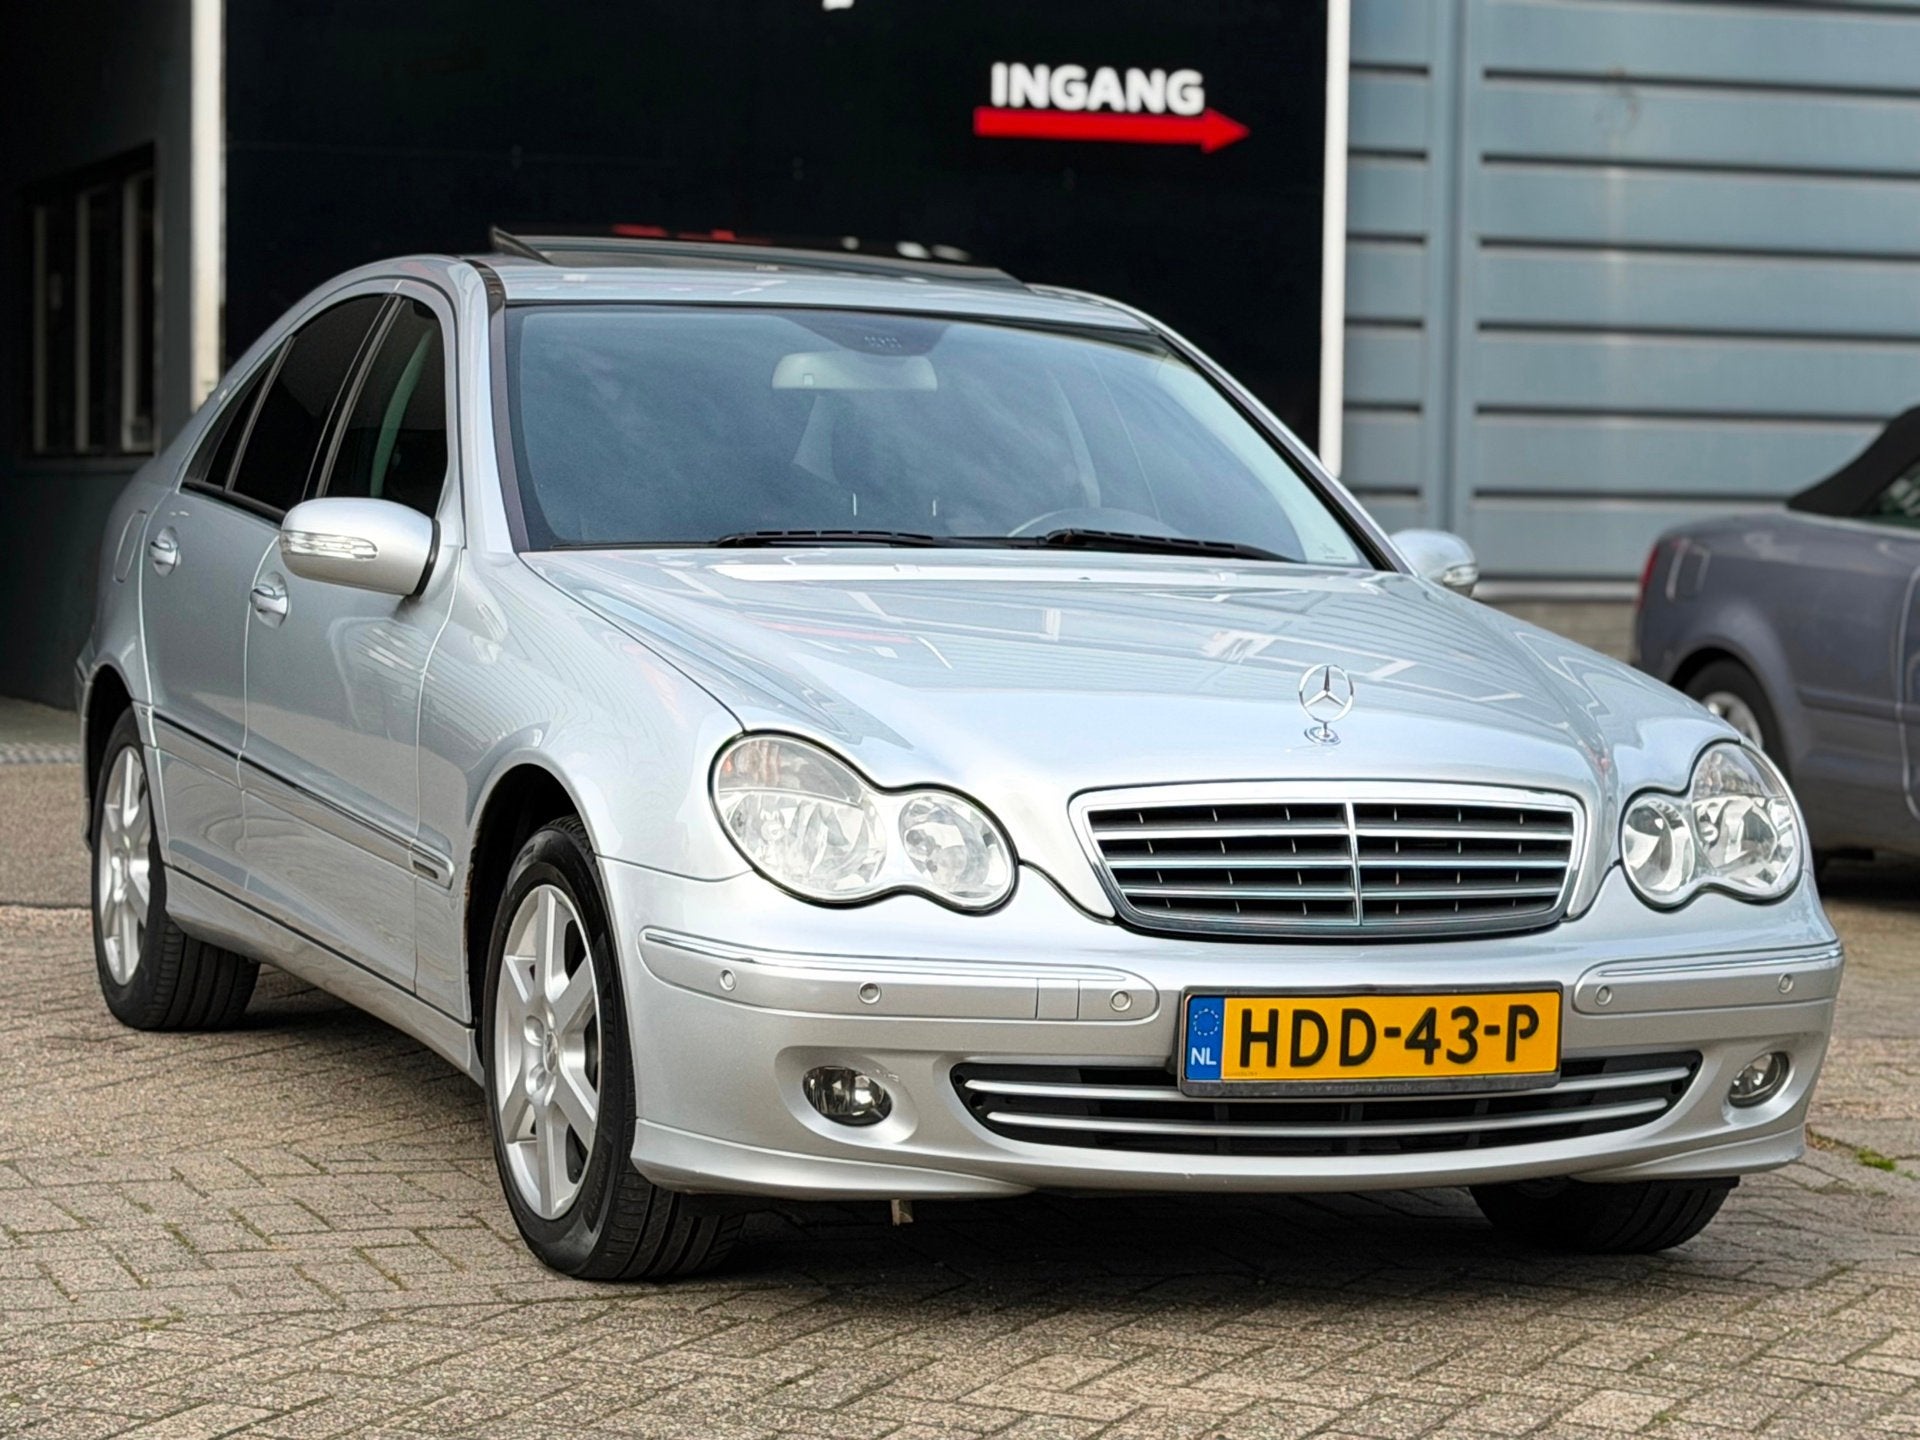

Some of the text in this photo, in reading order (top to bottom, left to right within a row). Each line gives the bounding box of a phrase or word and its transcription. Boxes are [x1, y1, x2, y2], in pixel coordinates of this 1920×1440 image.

[991, 62, 1205, 115] INGANG
[1190, 1047, 1217, 1065] NL
[1239, 1004, 1539, 1068] HDD-43-P
